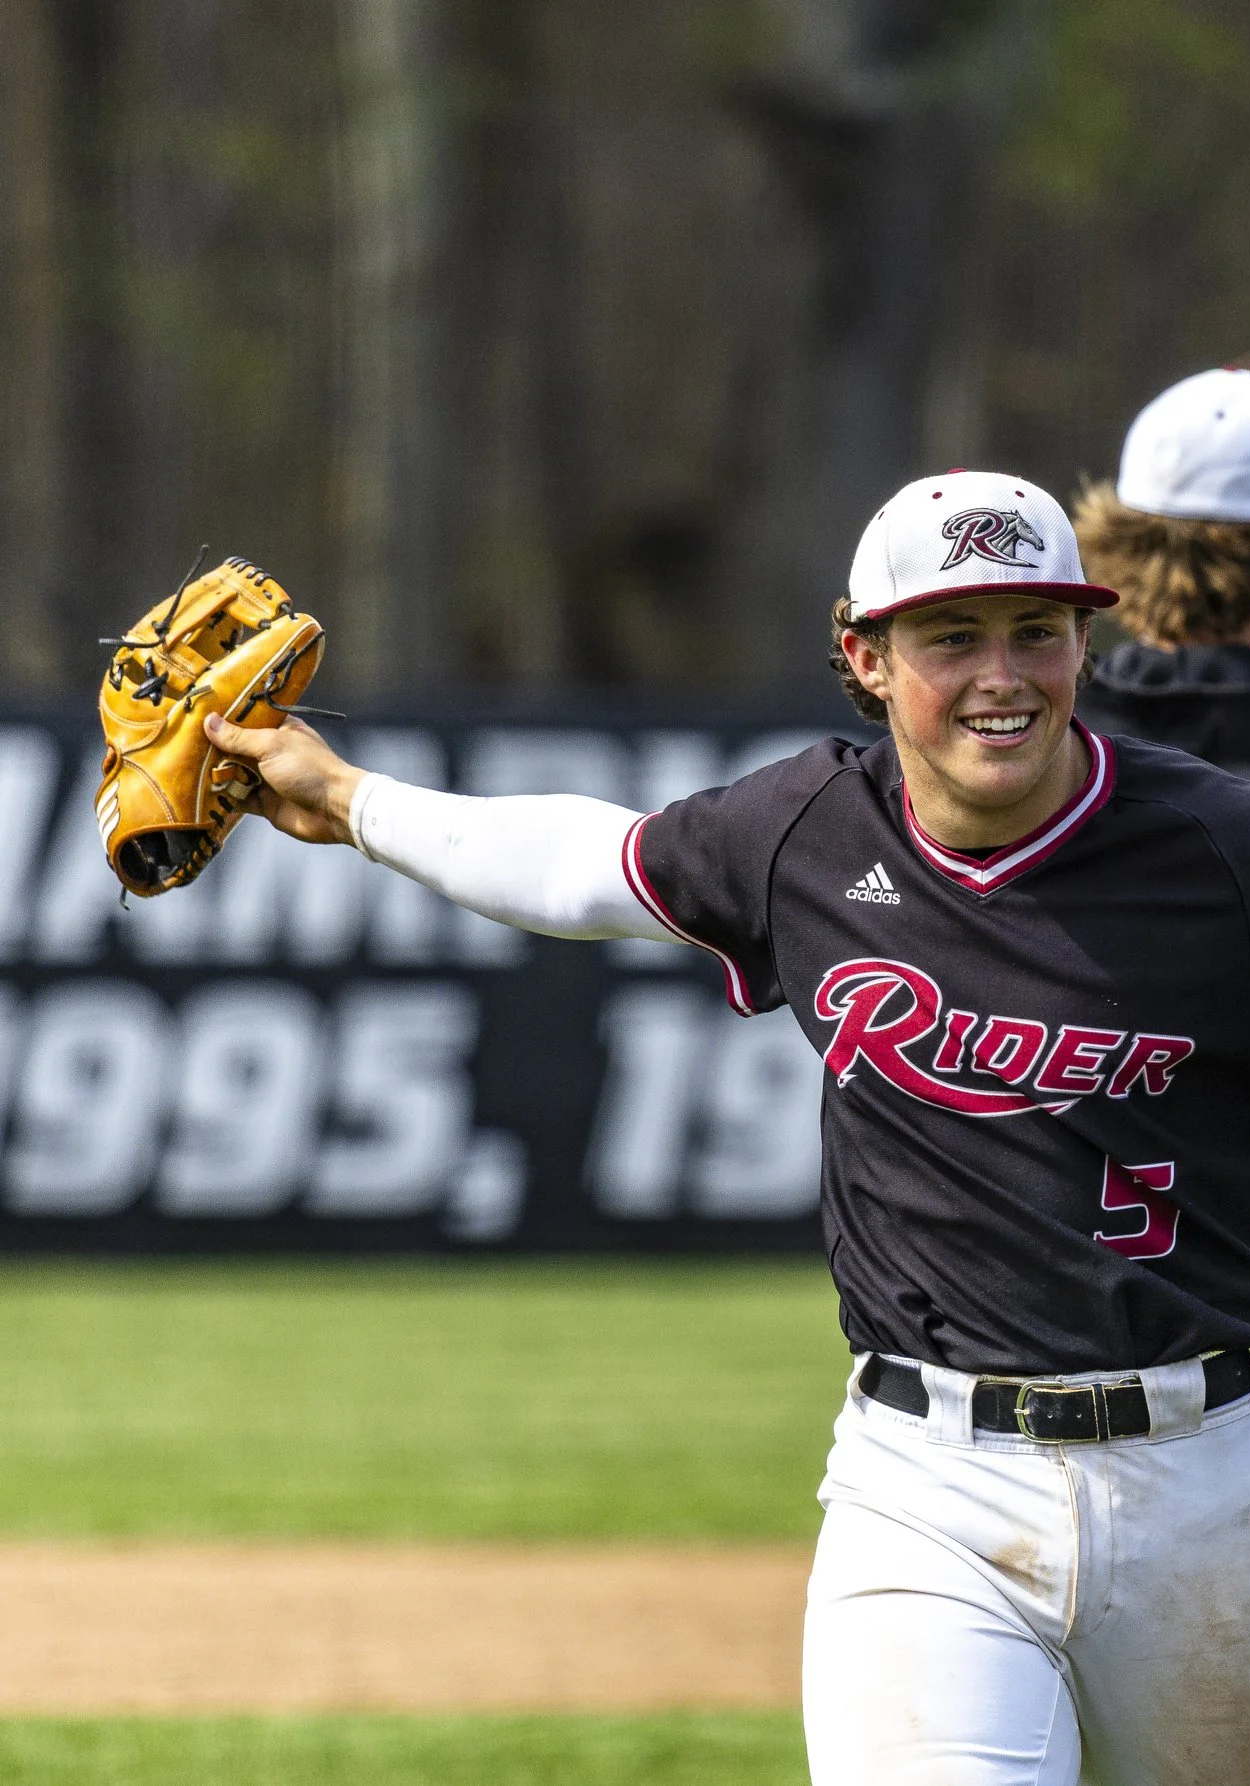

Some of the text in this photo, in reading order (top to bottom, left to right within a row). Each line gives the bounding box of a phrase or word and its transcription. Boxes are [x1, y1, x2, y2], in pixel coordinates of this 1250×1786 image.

[938, 507, 1040, 571] R
[845, 887, 901, 905] adidas
[814, 957, 1195, 1118] RIDER
[0, 984, 522, 1236] 995,
[1094, 1154, 1180, 1260] 5
